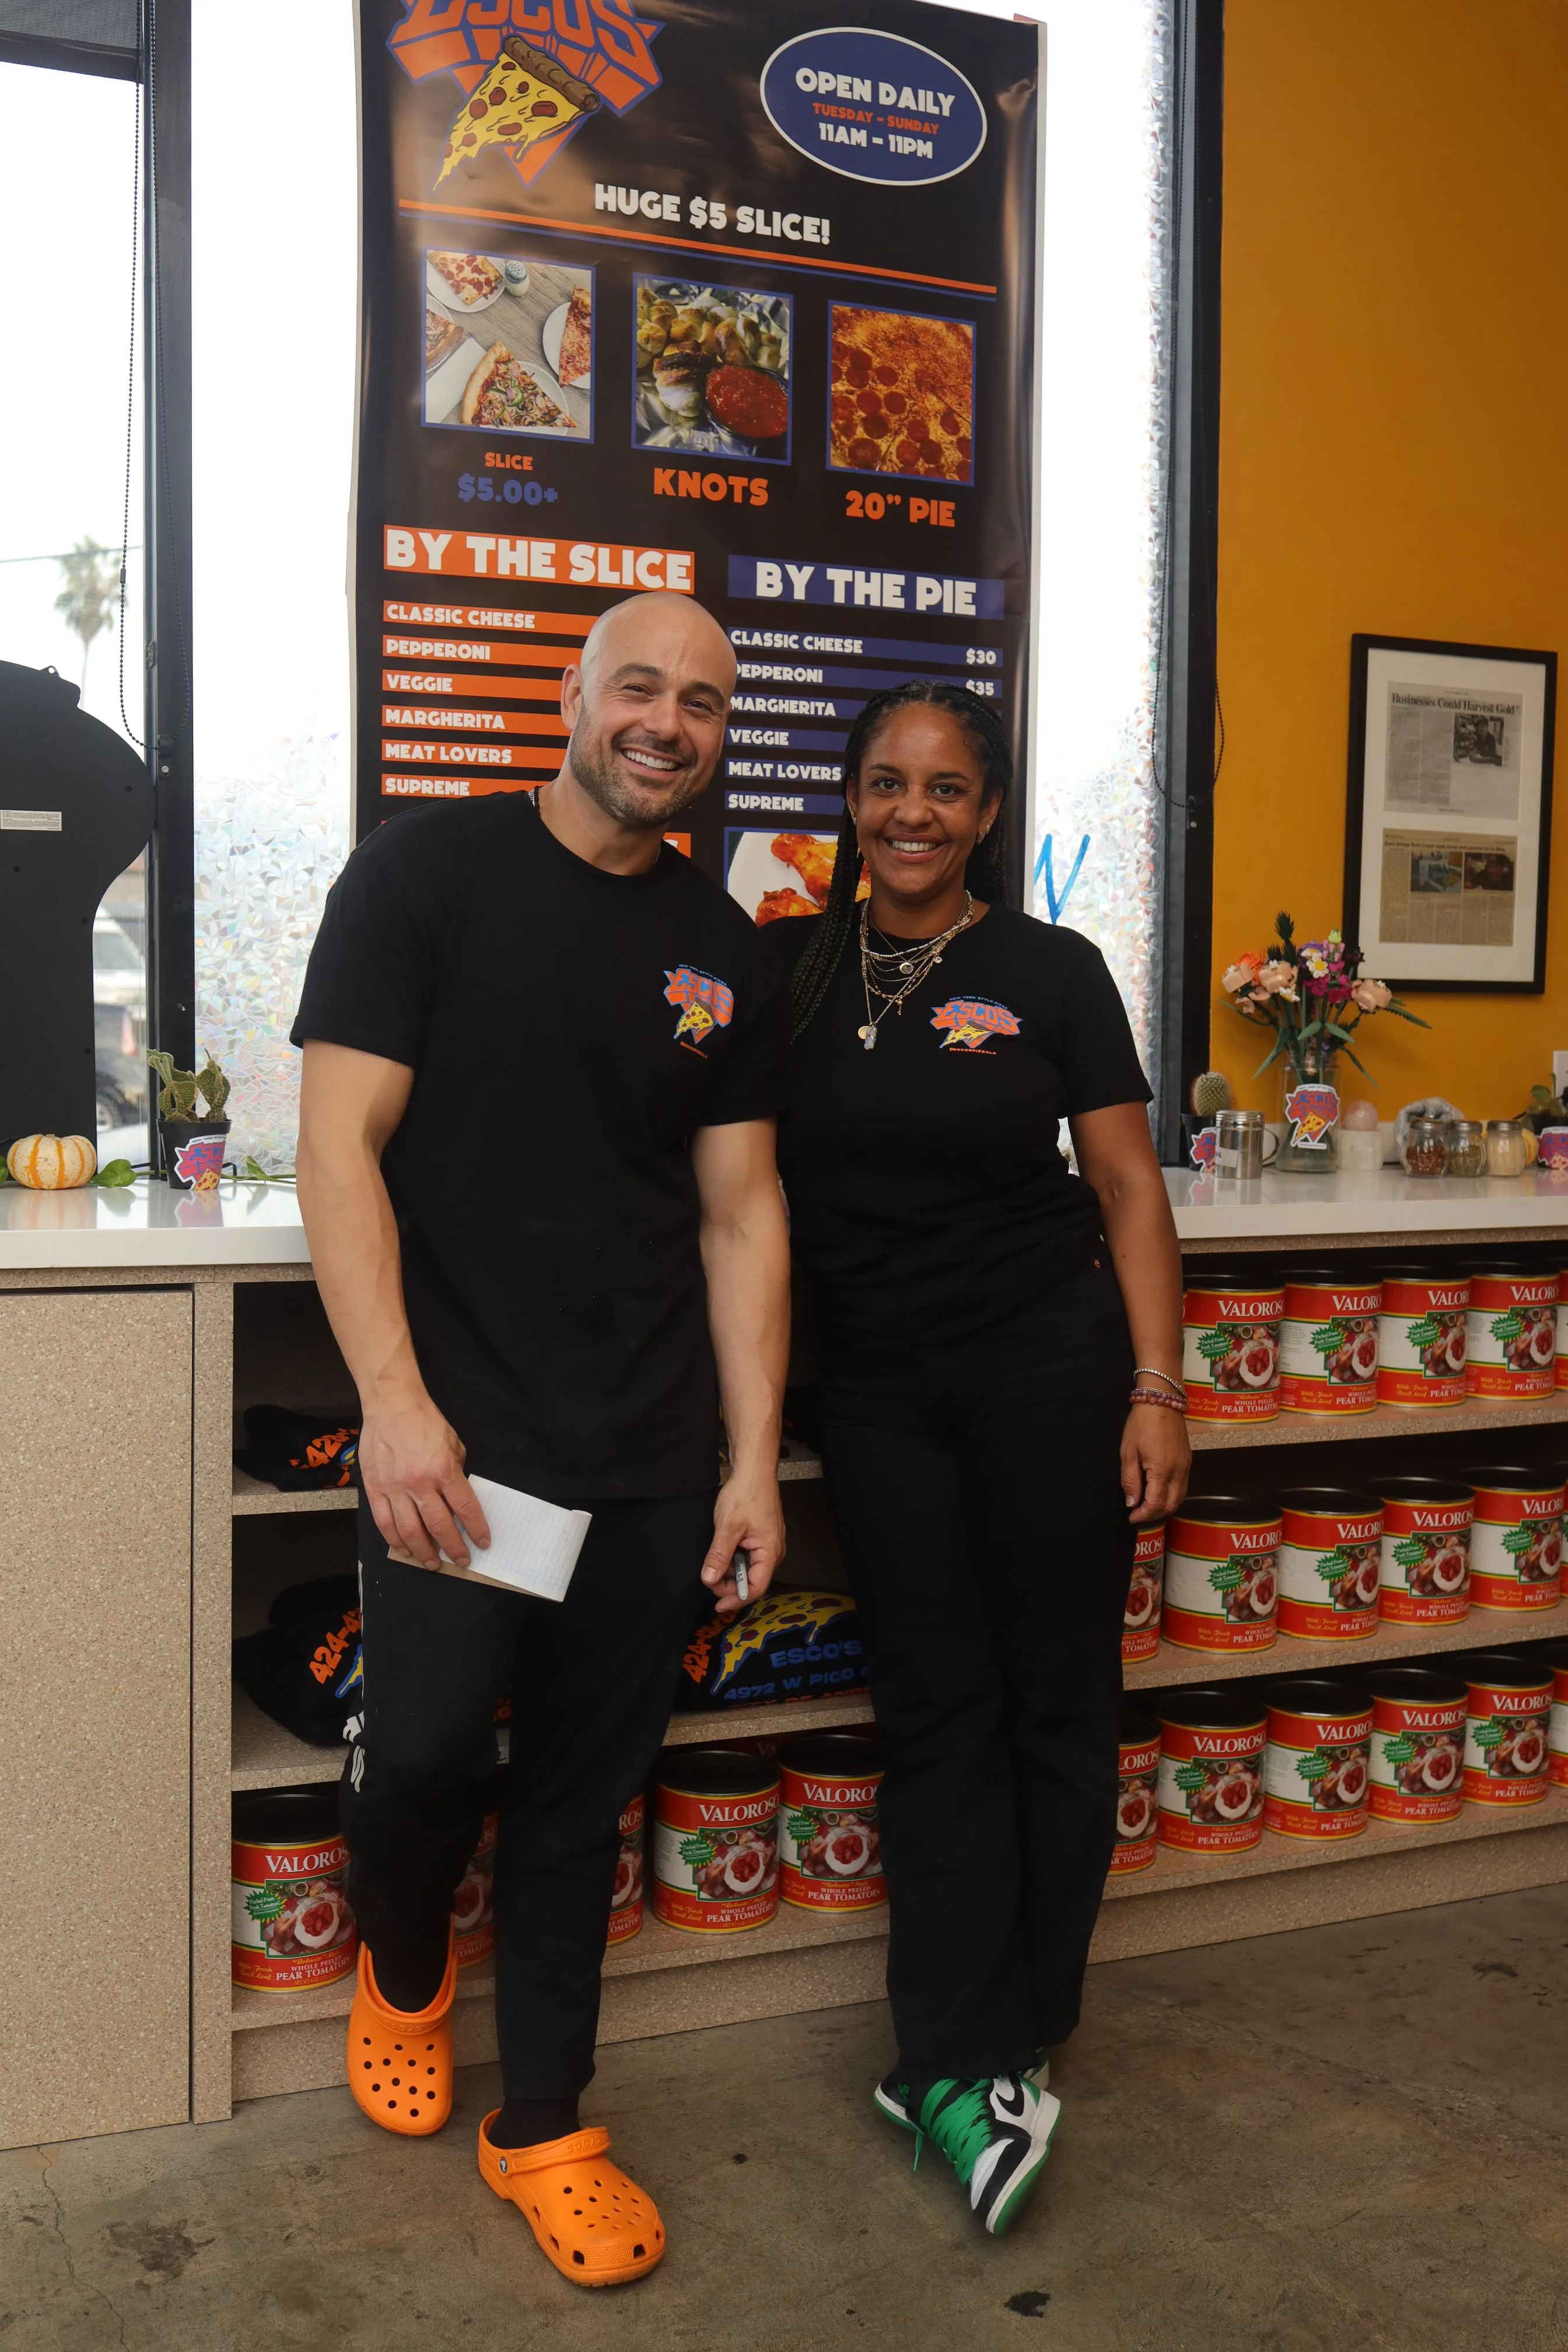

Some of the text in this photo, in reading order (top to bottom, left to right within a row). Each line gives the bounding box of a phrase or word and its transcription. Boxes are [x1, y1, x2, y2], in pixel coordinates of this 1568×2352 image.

[796, 68, 955, 117] OPEN DAILY
[813, 103, 873, 123] TUESDAY
[887, 116, 939, 135] SUNDAY
[819, 123, 867, 147] 11AM
[888, 134, 933, 159] 11PM
[595, 183, 830, 245] HUGE $5 SLICE!
[485, 452, 533, 471] SLICE
[457, 473, 558, 506] $5.00+
[653, 468, 768, 506] KNOTS
[910, 498, 955, 527] PIE
[387, 529, 691, 590] BY THE SLICE
[757, 561, 976, 615] BY THE PIE
[387, 604, 536, 629] CLASSIC CHEESE
[387, 639, 490, 660] PEPPERONI
[730, 630, 863, 654] CLASSIC CHEESE
[966, 648, 996, 666] $30
[386, 674, 452, 692] VEGGIE
[966, 680, 994, 696] $35
[730, 696, 836, 717] MARGHERITA
[1391, 693, 1436, 707] Businesses
[1438, 698, 1461, 709] Could
[1464, 701, 1493, 712] Harvest
[386, 709, 505, 729] MARGHERITA
[729, 729, 789, 746] VEGGIE
[386, 744, 512, 764] MEAT LOVERS
[729, 761, 841, 781] MEAT LOVERS
[386, 778, 470, 795] SUPREME
[729, 794, 804, 811] SUPREME
[936, 1000, 1020, 1034] ESCOS
[1332, 1293, 1381, 1311] VALORO
[1231, 1530, 1282, 1549] VALORO
[1336, 1520, 1384, 1539] VALORO
[1340, 1623, 1360, 1631] PEAR
[1233, 1634, 1254, 1643] PEAR
[770, 1640, 862, 1668] ESCO'S
[724, 1682, 775, 1700] 4972
[782, 1676, 803, 1689] W
[810, 1667, 854, 1685] PICO
[1317, 1721, 1371, 1741] VALORO
[1495, 1789, 1517, 1797] PEAR
[808, 1888, 881, 1901] PEAR TOMATOES
[706, 1903, 773, 1923] PEAR TOMATOES
[747, 1901, 766, 1911] PEELED
[254, 1965, 272, 1973] Fresh
[276, 1972, 303, 1981] PEAR
[306, 1957, 350, 1978] TOMATOES
[291, 1955, 342, 1972] WHOLE PEELED
[256, 1973, 272, 1981] Leaf
